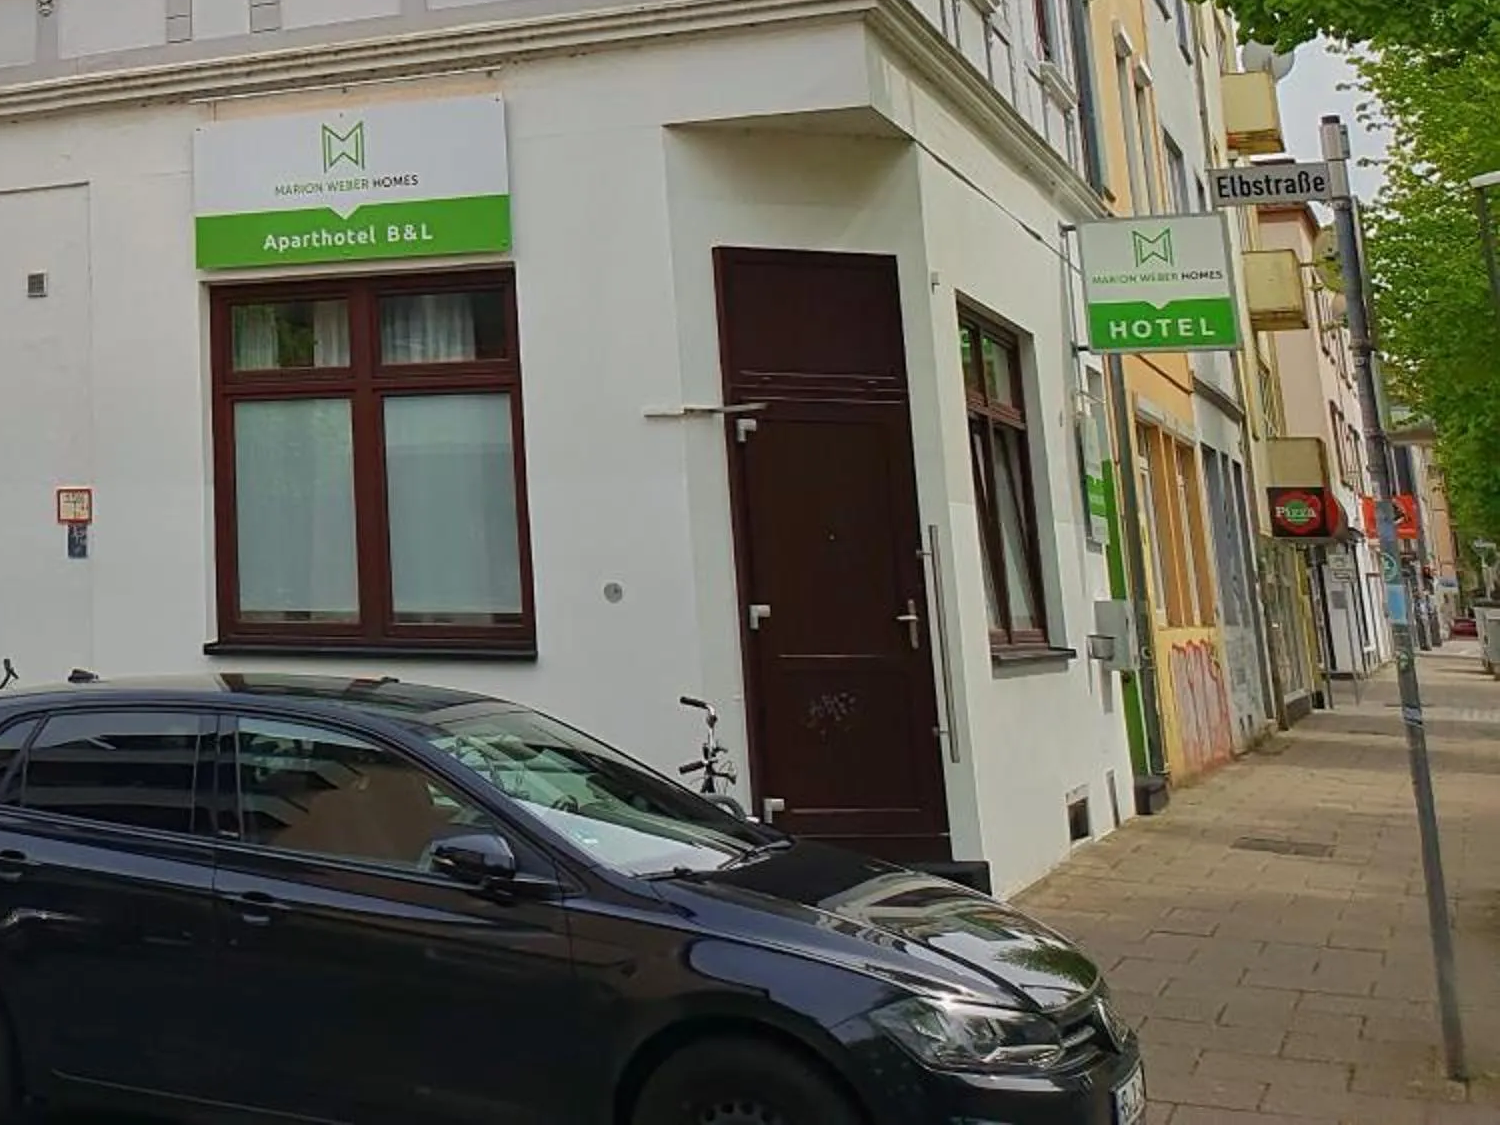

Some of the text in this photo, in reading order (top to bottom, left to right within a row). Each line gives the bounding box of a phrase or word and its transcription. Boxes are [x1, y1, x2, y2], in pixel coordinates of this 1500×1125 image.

[275, 174, 419, 196] MARION WEBER HOMES
[1217, 170, 1326, 199] Elbstraße
[263, 226, 376, 252] Aparthotel
[1181, 270, 1223, 280] HOMES
[1109, 318, 1216, 340] HOTEL
